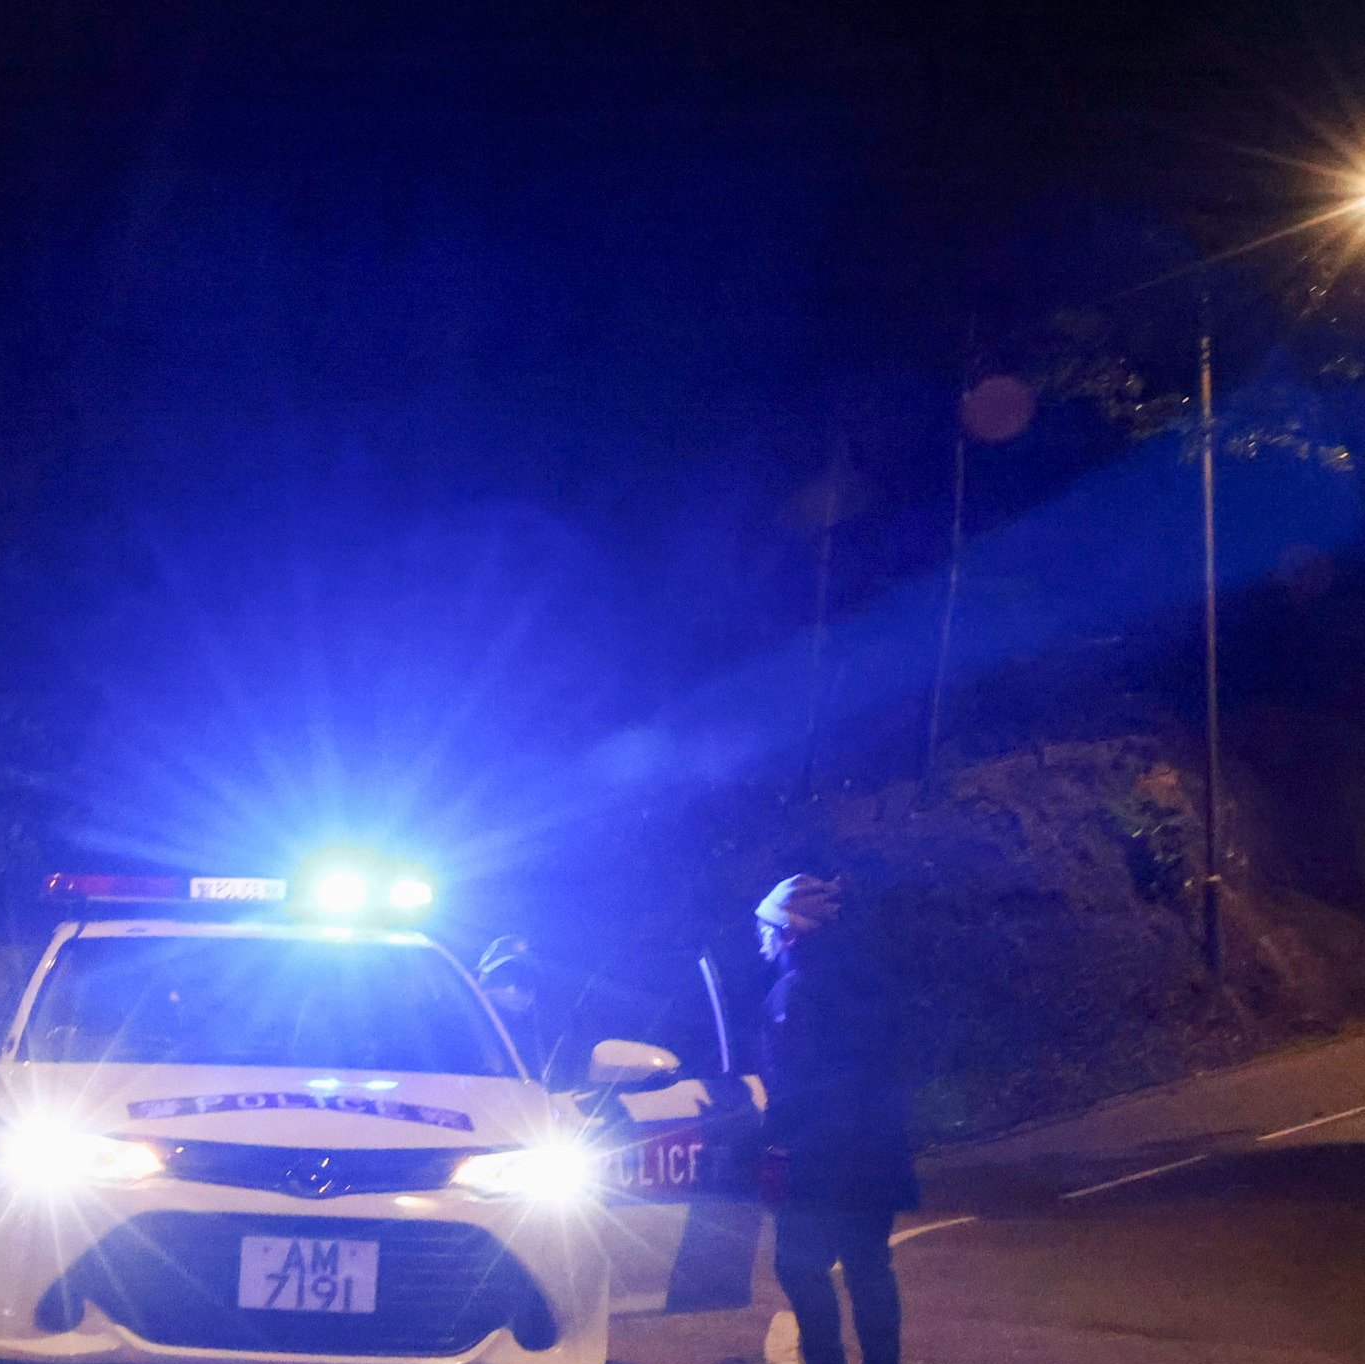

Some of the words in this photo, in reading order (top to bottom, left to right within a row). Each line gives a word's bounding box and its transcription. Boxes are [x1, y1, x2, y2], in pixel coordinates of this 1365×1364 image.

[600, 1143, 703, 1187] OLIC
[279, 1238, 340, 1276] AM
[263, 1273, 354, 1311] 7191
